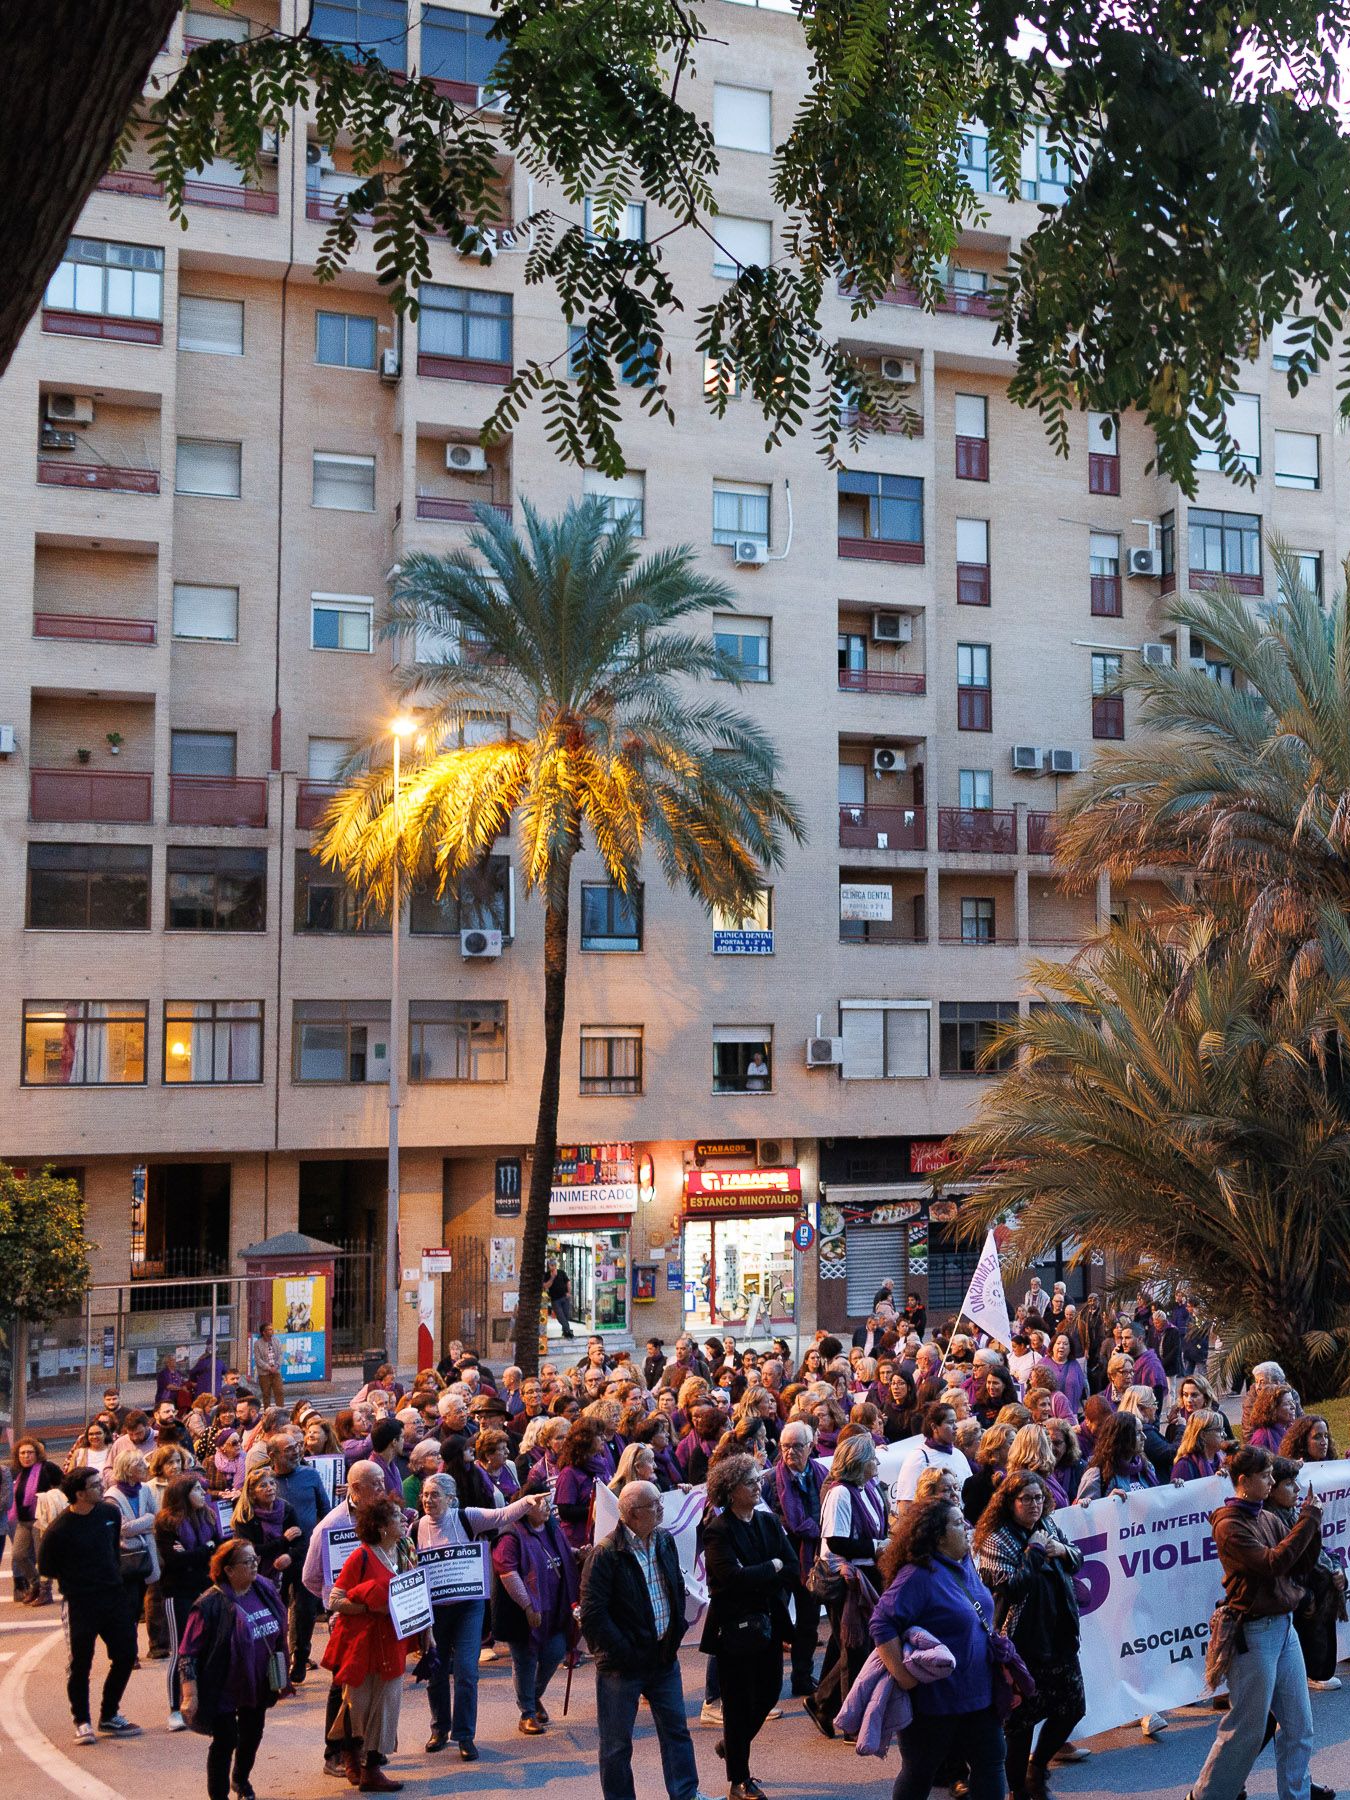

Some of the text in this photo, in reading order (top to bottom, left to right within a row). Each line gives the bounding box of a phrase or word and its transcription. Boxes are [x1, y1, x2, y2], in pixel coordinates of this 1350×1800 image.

[868, 891, 891, 900] DENTAL
[706, 1145, 747, 1153] TABACOS
[720, 1172, 789, 1186] TABACOS
[690, 1194, 799, 1208] ESTANCO MINOTAURO
[1119, 1521, 1147, 1541] DÍA
[444, 1549, 455, 1558] 37
[456, 1548, 477, 1556] años
[1118, 1519, 1347, 1579] VIOLE DE
[457, 1585, 484, 1594] MACHISTA
[1169, 1645, 1194, 1664] LA
